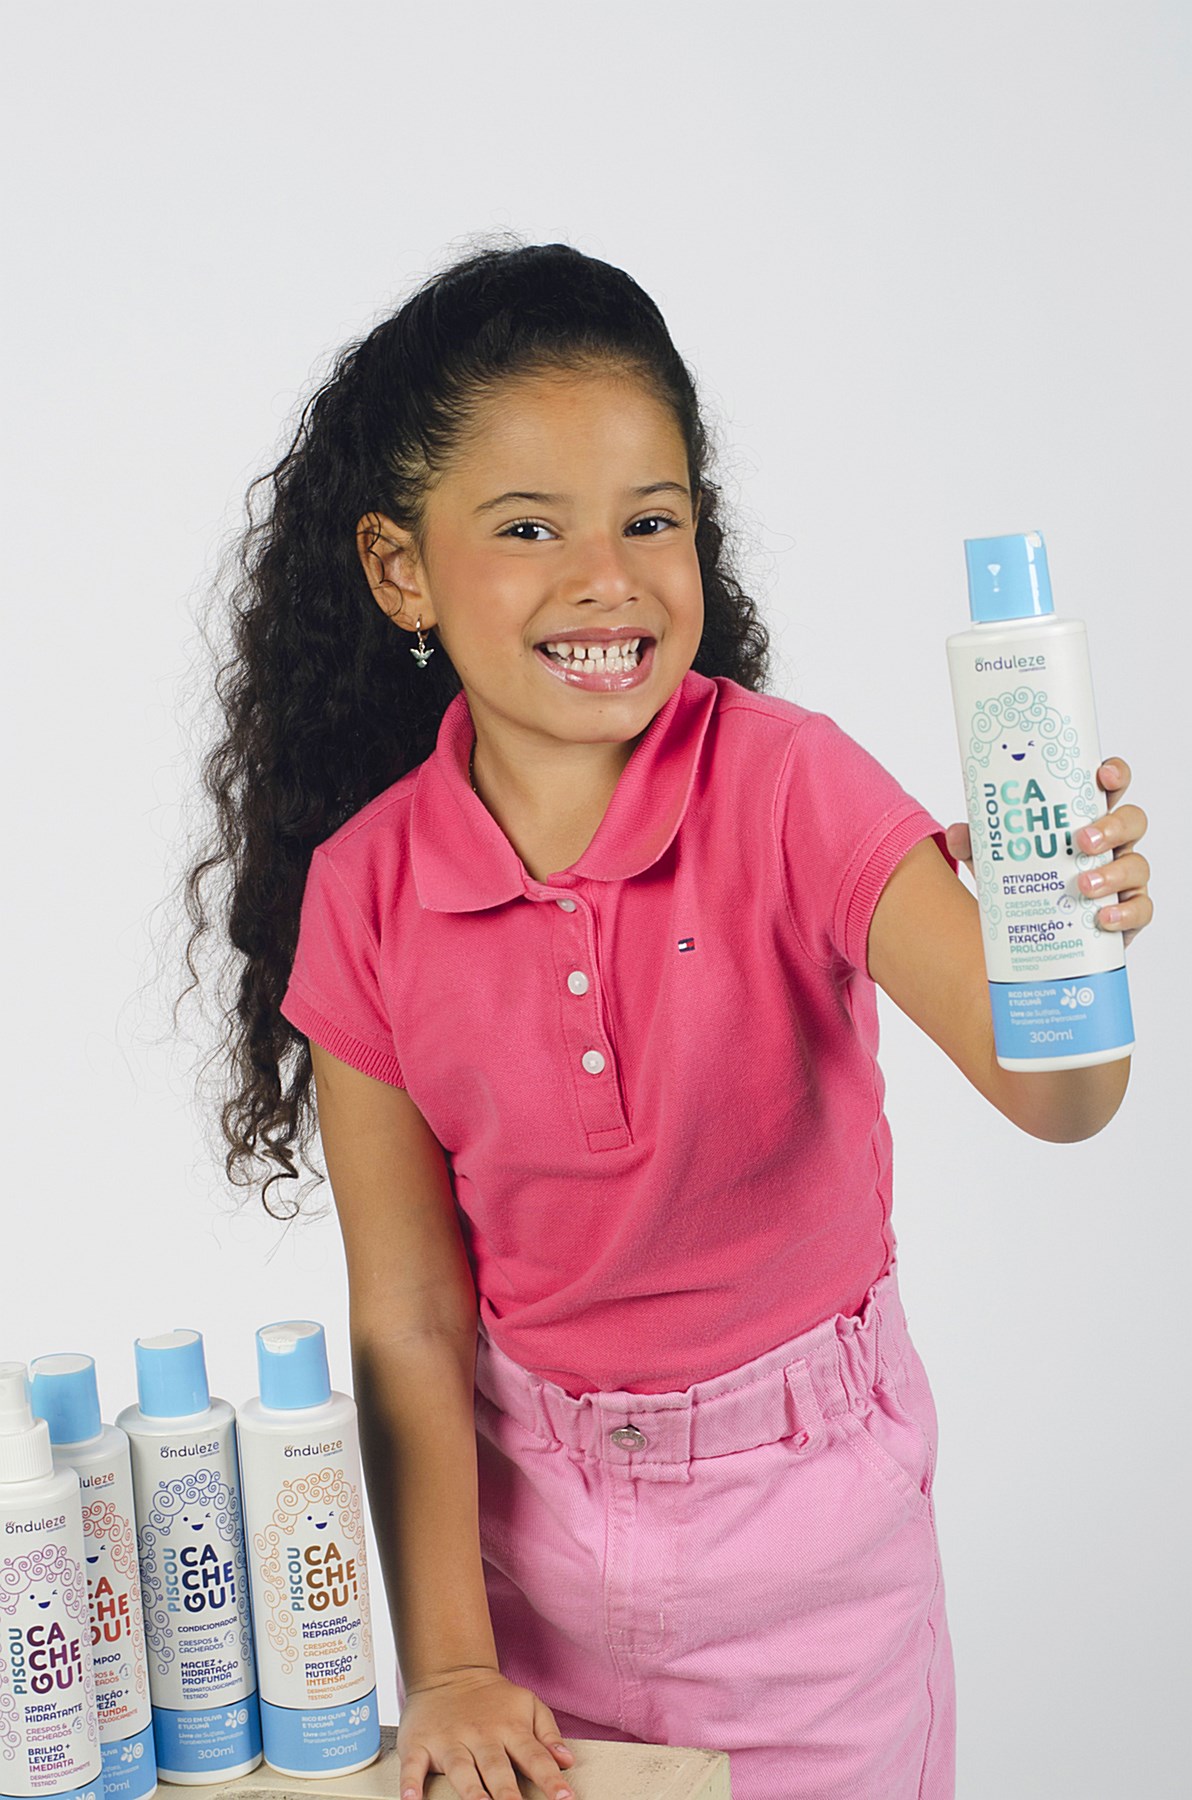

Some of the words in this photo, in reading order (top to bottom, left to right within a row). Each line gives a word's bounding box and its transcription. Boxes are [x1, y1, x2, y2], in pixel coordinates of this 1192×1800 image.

[975, 655, 1046, 672] onduleze
[1000, 778, 1047, 806] CA
[983, 782, 1005, 862] PISCOU
[1003, 803, 1071, 835] CHE
[1006, 830, 1074, 862] OU!
[1002, 871, 1059, 885] ATIVADOR
[1003, 885, 1017, 895] DE
[1018, 880, 1066, 894] CACHOS
[1004, 899, 1042, 910] CRESPOS
[1005, 906, 1057, 918] CACHEADOS
[1007, 919, 1064, 934] DEFINIÇÃO
[1008, 931, 1055, 944] FIXAÇÃO
[1010, 938, 1084, 954] PROLONGADA
[1012, 964, 1040, 972] TESTADO
[1029, 1028, 1074, 1043] 300ml
[160, 1441, 220, 1458] onduleze
[284, 1440, 343, 1458] onduleze
[79, 1472, 115, 1488] uleze
[5, 1515, 66, 1534] onduleze
[179, 1543, 219, 1568] CA
[303, 1541, 342, 1567] CA
[163, 1547, 181, 1613] PISCOU
[181, 1560, 235, 1591] CHE
[286, 1547, 305, 1611] PISCOU
[305, 1558, 357, 1589] CHE
[183, 1582, 236, 1613] OU!
[307, 1580, 359, 1612] OU!
[88, 1592, 129, 1624] HE
[177, 1616, 238, 1633] CONDICIONADOR
[302, 1615, 348, 1630] MÁSCARA
[302, 1618, 362, 1639] REPARADORA
[26, 1621, 66, 1647] CA
[178, 1637, 213, 1647] CRESPOS
[178, 1642, 224, 1654] CACHEADOS
[303, 1640, 337, 1650] CRESPOS
[28, 1638, 81, 1671] CHE
[303, 1645, 348, 1657] CACHEADOS
[8, 1627, 28, 1695] PISCOU
[93, 1652, 121, 1666] MPOO
[180, 1658, 216, 1669] MACIEZ
[305, 1655, 353, 1670] PROTEÇÃO
[181, 1660, 239, 1677] HIDRATAÇÃO
[306, 1664, 352, 1678] NUTRIÇÃO
[30, 1660, 83, 1695] OU!
[94, 1676, 119, 1687] EADOS
[181, 1671, 232, 1685] PROFUNDA
[306, 1674, 346, 1687] INTENSA
[96, 1689, 123, 1702] RIÇÃO
[183, 1692, 209, 1700] TESTADO
[308, 1693, 333, 1701] TESTADO
[24, 1702, 57, 1714] SPRAY
[25, 1702, 83, 1723] HIDRATANTE
[97, 1705, 128, 1719] FUNDA
[26, 1723, 61, 1735] CRESPOS
[26, 1729, 72, 1742] CACHEADOS
[28, 1744, 64, 1756] BRILHO
[198, 1745, 235, 1760] 300ml
[322, 1741, 358, 1758] 300ml
[28, 1752, 65, 1765] LEVEZA
[29, 1758, 74, 1773] IMEDIATA
[31, 1779, 58, 1788] TESTADO
